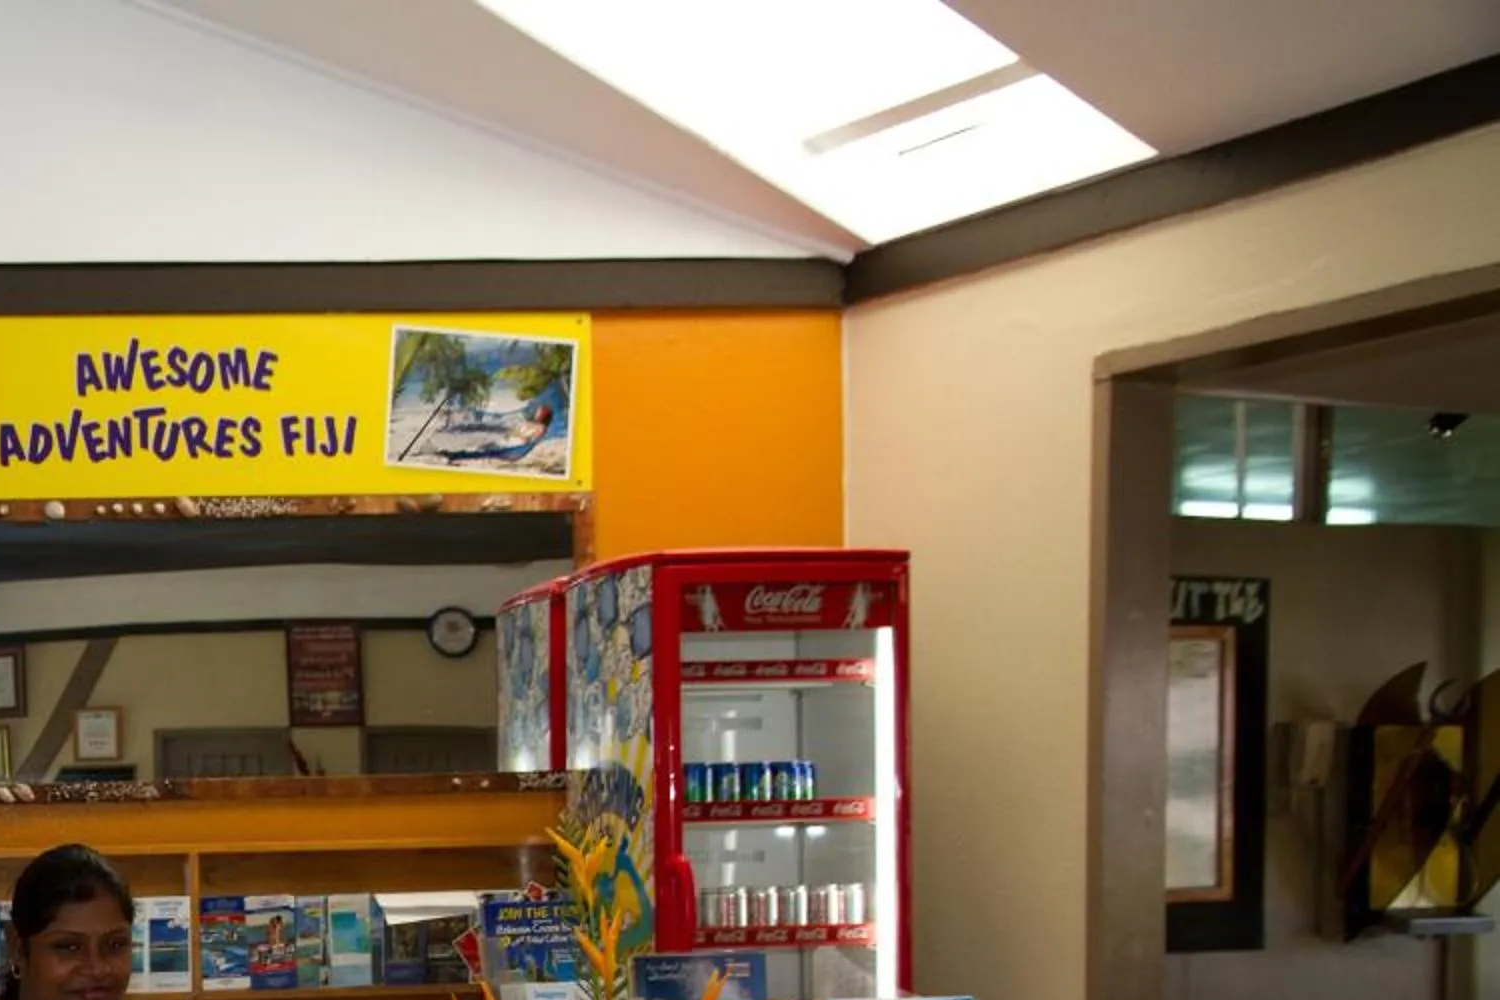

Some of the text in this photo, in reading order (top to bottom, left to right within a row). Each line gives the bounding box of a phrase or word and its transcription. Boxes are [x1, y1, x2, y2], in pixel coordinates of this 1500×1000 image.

[76, 338, 278, 396] AWESOME
[0, 406, 357, 467] ADVENTURES FIJI
